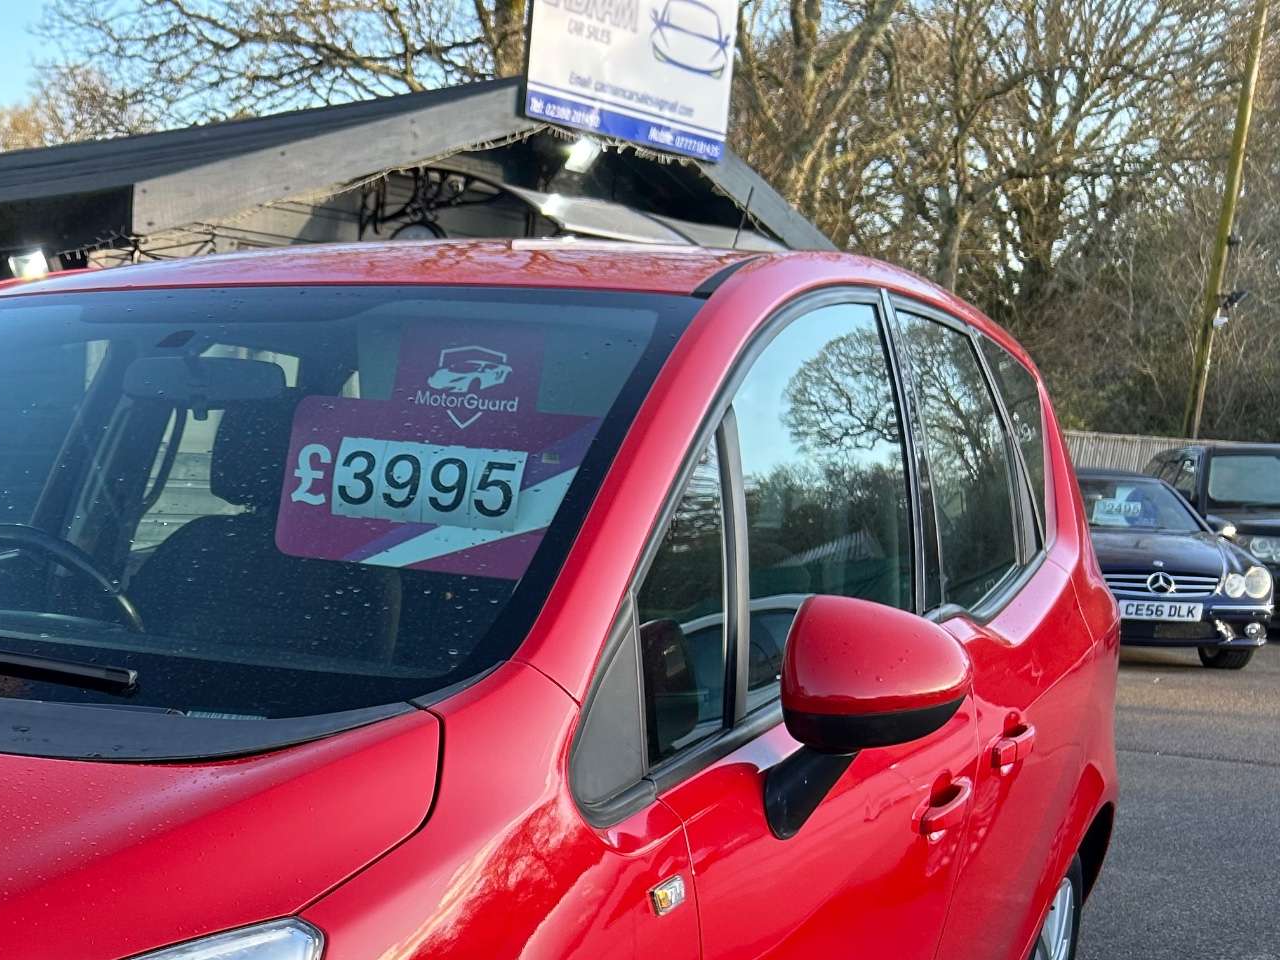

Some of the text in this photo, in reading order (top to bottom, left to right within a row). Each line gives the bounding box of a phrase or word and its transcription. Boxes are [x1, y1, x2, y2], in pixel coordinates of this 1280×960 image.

[414, 389, 519, 413] MotorGuard
[1124, 603, 1197, 619] CE56 DLK
